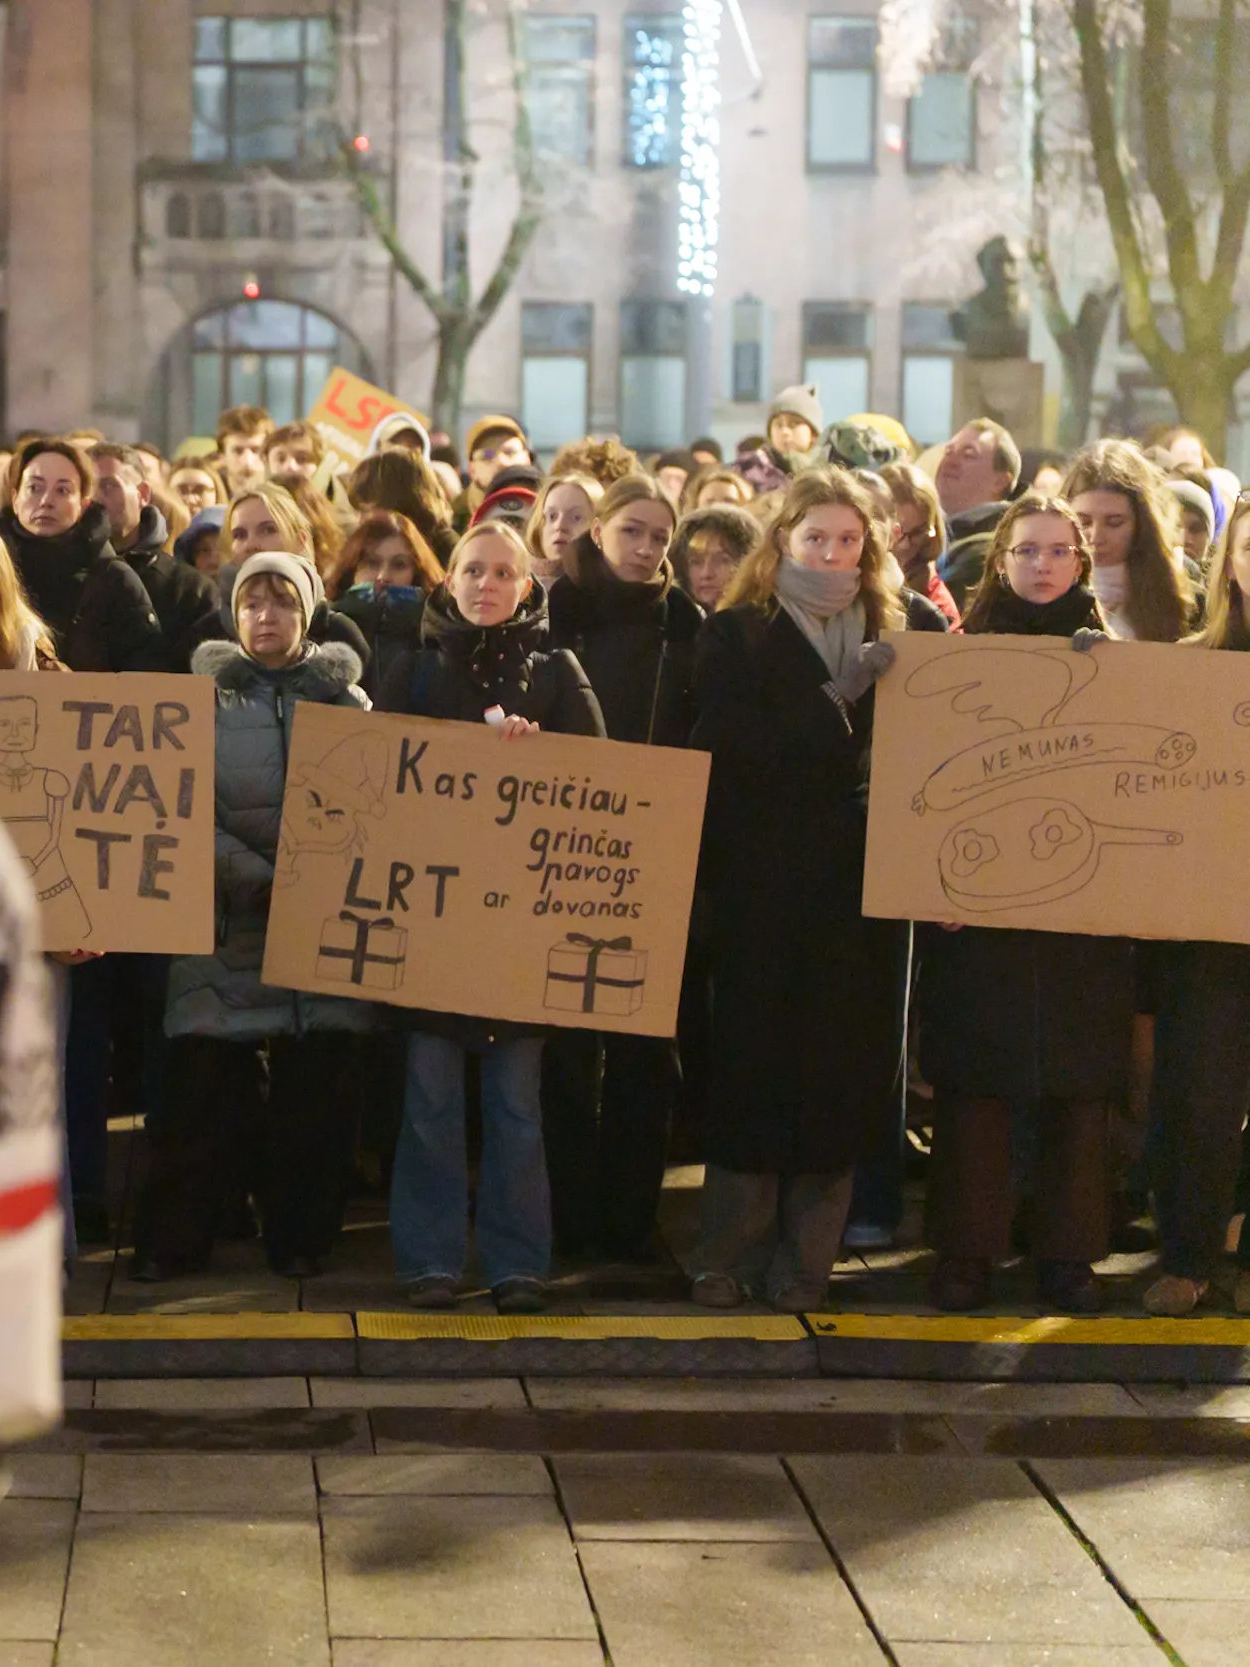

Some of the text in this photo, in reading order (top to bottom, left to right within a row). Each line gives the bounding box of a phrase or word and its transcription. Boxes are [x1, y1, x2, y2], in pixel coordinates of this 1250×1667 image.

[62, 700, 190, 752] TAR
[395, 736, 478, 801] Kas
[981, 734, 1095, 777] NEMUNAS
[71, 762, 195, 819] NAI
[1114, 769, 1246, 799] REMIGIJUS
[74, 820, 180, 901] TĖ
[526, 826, 633, 871] grinčas
[343, 857, 644, 920] LRT ar dovanas
[542, 860, 642, 898] pavogs
